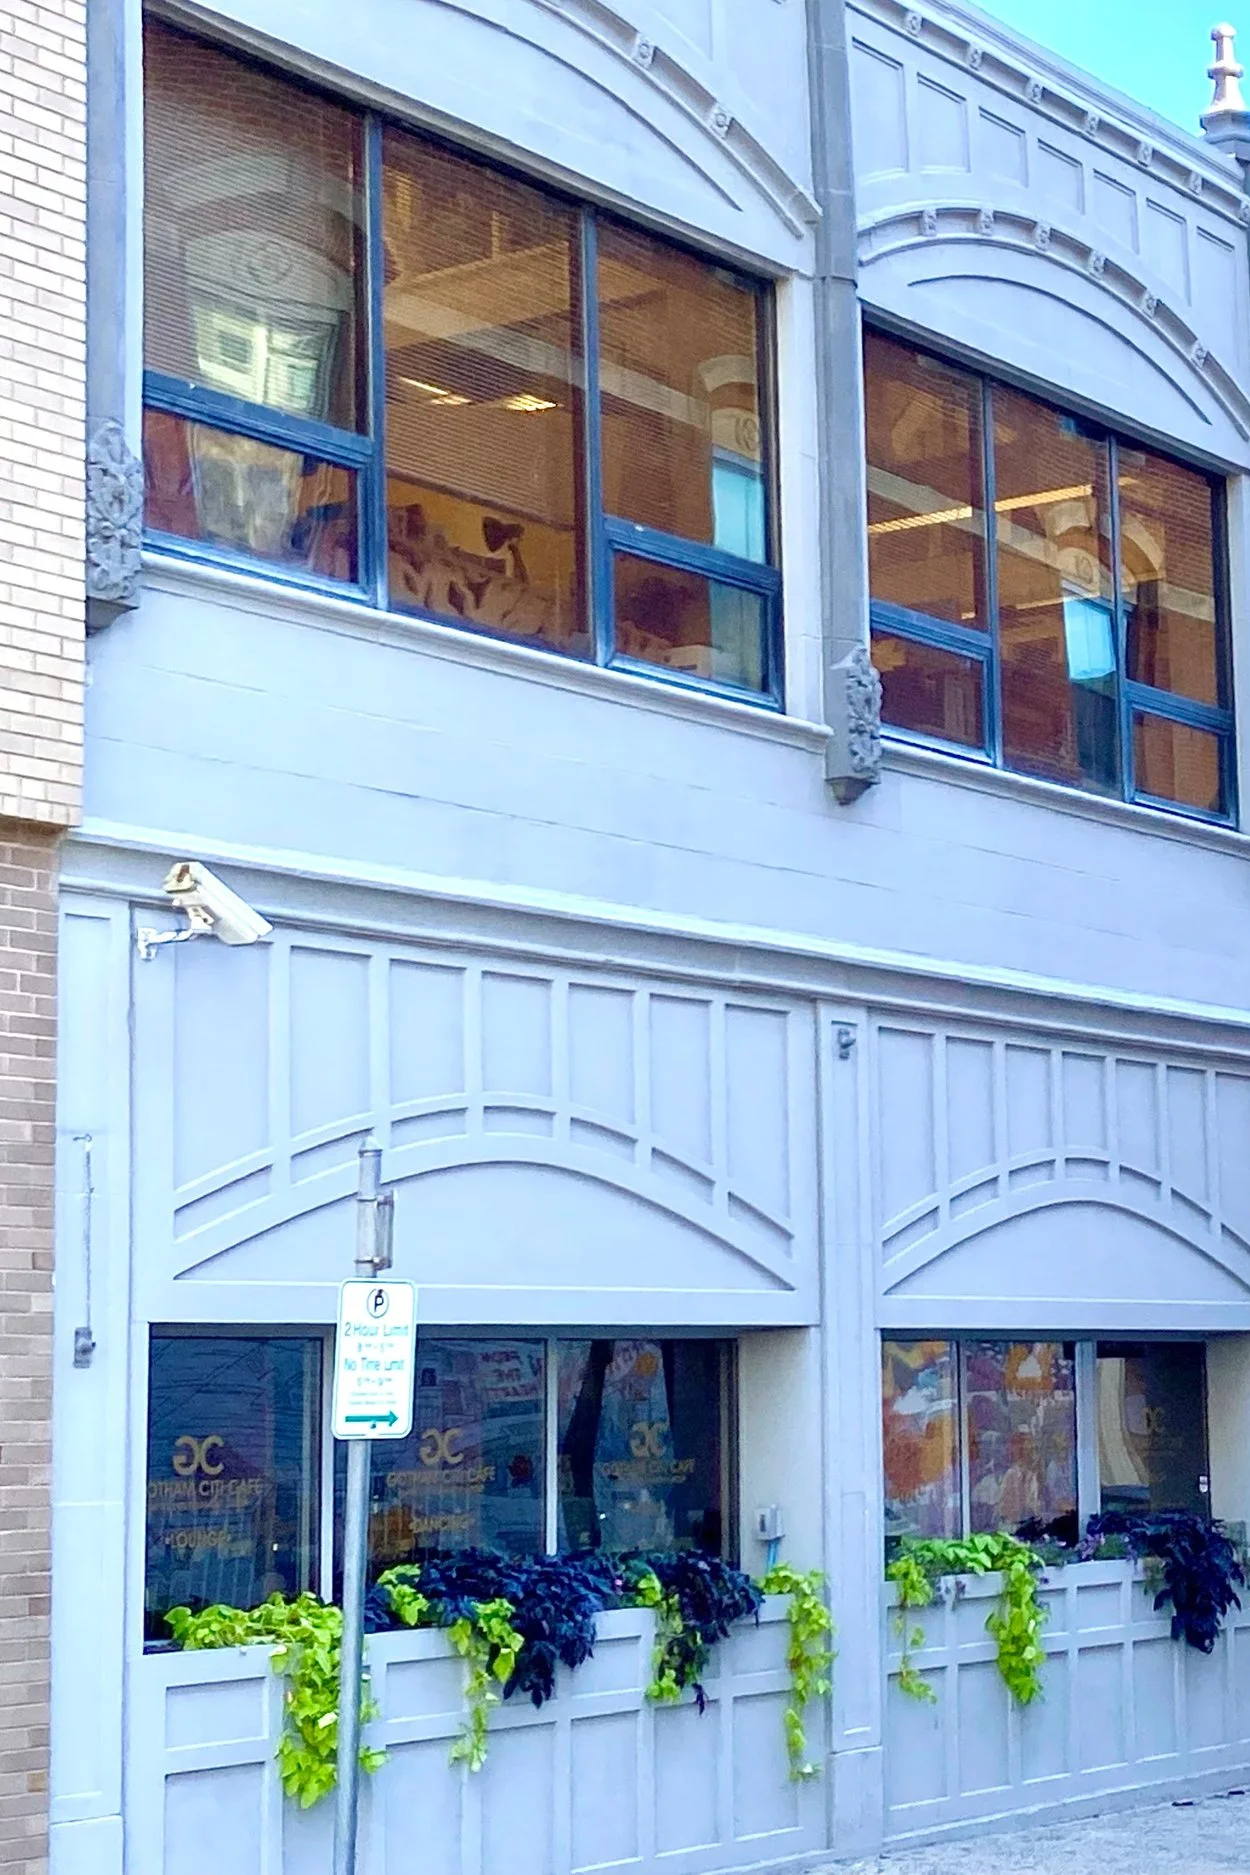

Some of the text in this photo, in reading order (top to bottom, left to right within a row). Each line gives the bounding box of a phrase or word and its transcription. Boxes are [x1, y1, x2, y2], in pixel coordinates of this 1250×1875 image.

[344, 1321, 409, 1336] 2 Hour Limit
[344, 1358, 357, 1371] No
[361, 1357, 381, 1371] Time
[149, 1480, 196, 1498] OTHAM
